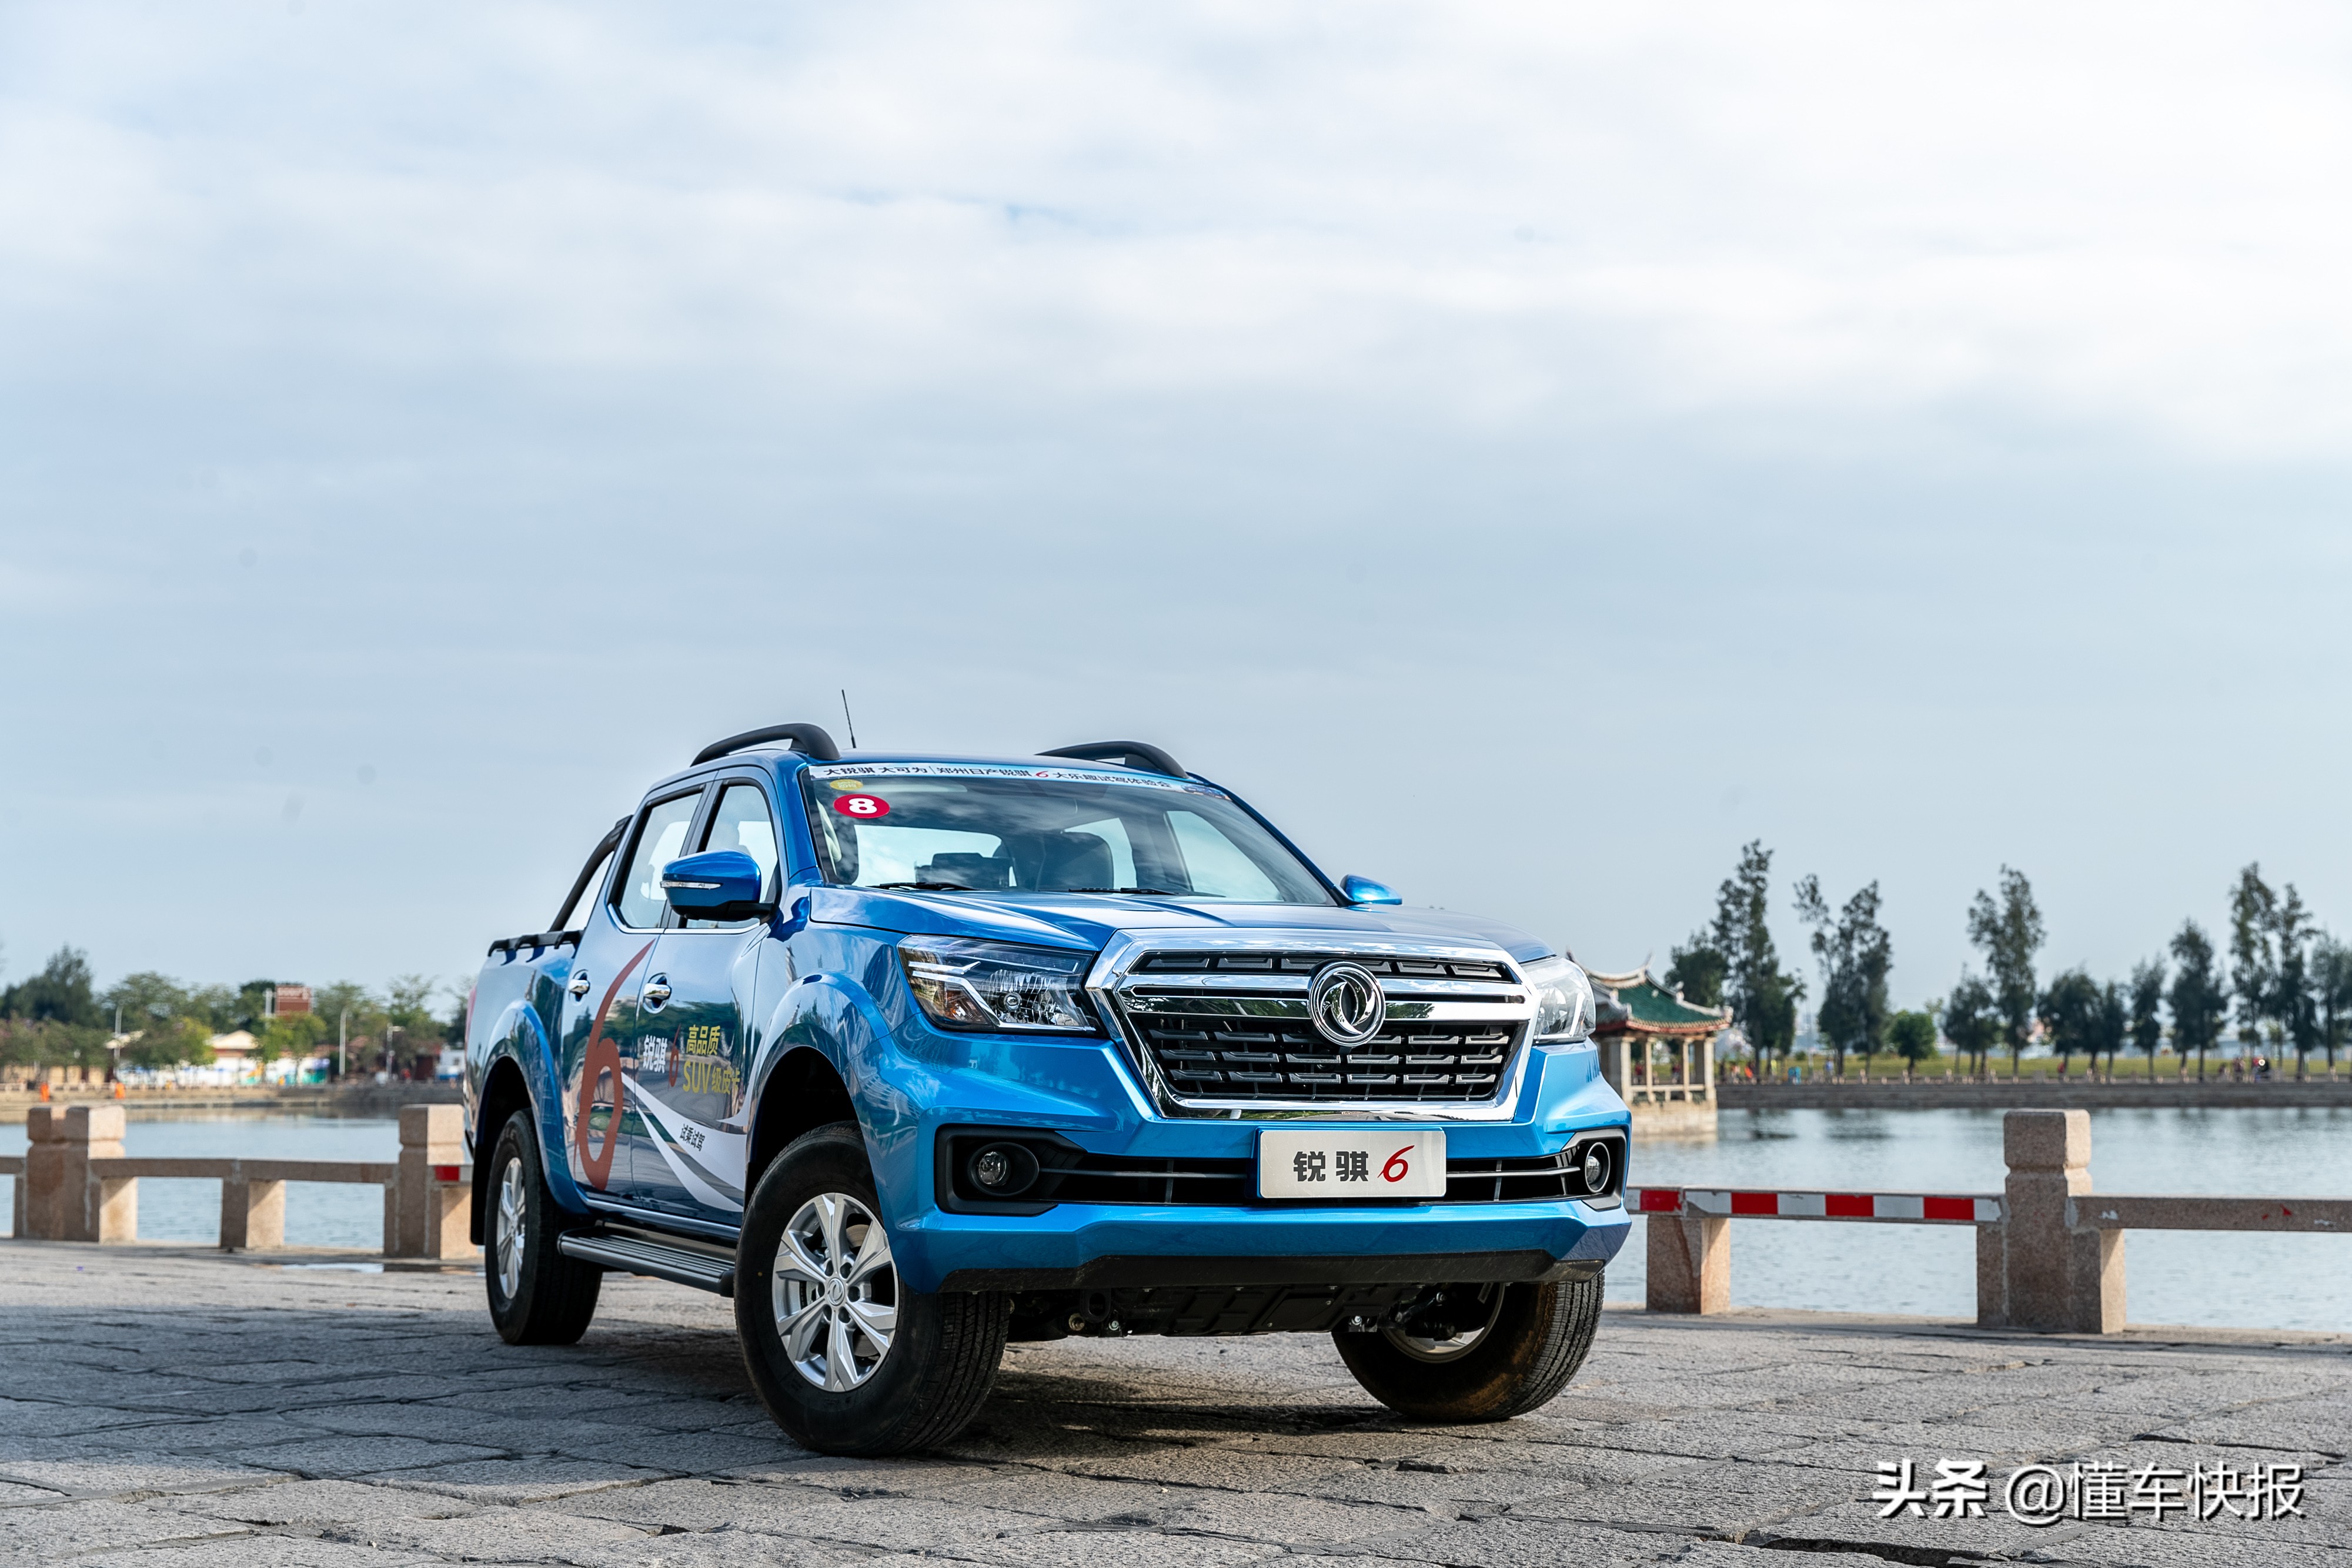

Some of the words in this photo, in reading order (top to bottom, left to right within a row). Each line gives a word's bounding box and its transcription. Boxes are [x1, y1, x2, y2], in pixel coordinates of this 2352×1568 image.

[848, 798, 877, 814] 8
[686, 1024, 720, 1055] 高品质
